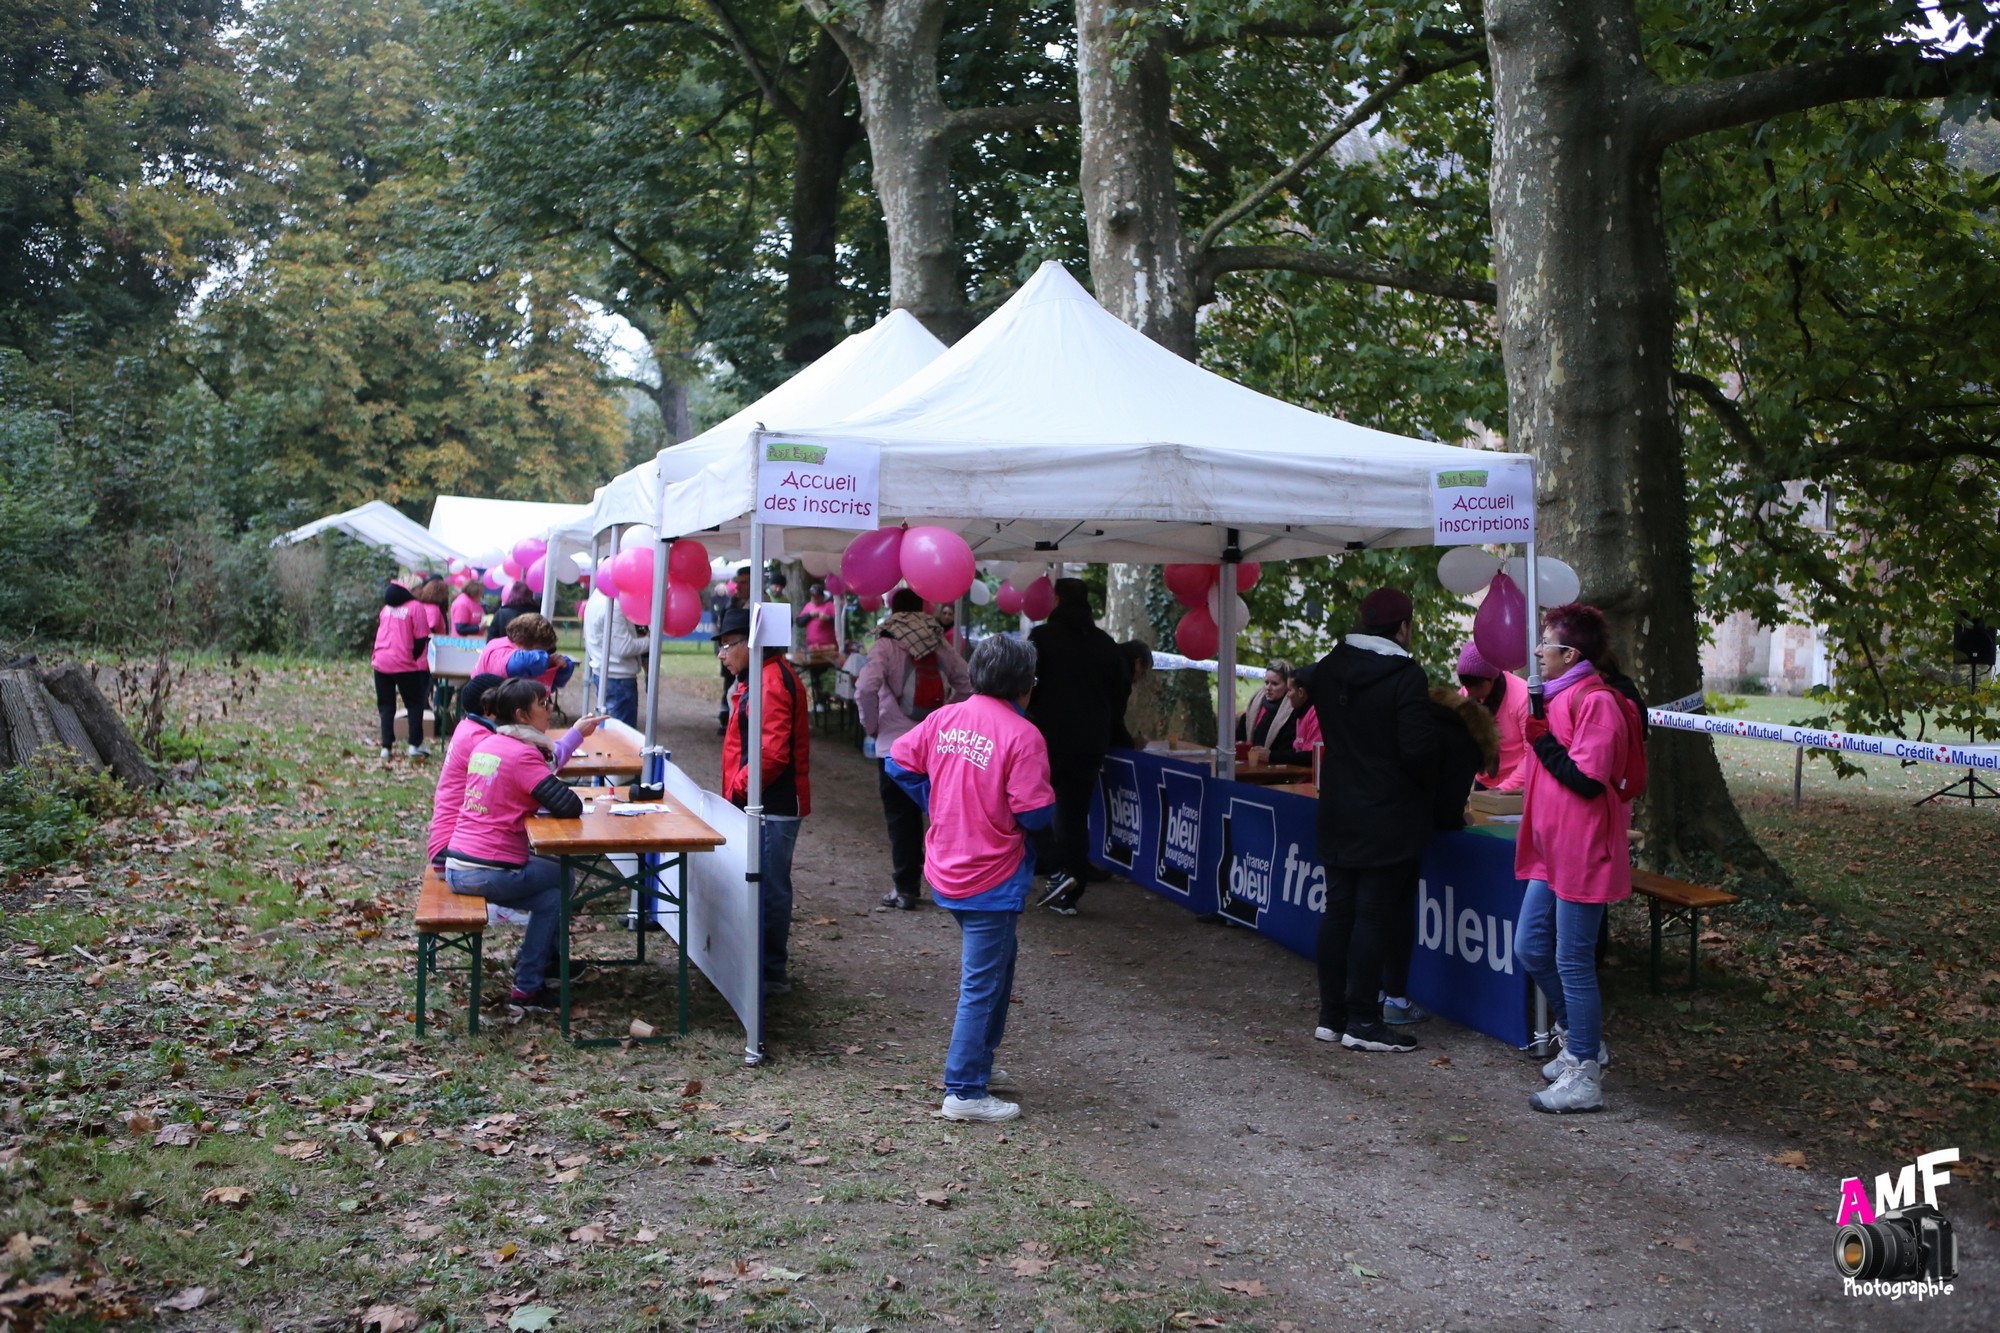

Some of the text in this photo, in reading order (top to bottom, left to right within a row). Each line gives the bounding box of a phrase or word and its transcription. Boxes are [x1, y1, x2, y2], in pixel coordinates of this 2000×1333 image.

[781, 471, 856, 492] Accueil
[764, 494, 872, 516] des inscrits
[1452, 494, 1514, 512] Accueil
[1439, 516, 1530, 533] inscriptions
[938, 728, 994, 756] MARCHER
[1663, 714, 1695, 728] Mutuel
[1704, 719, 1735, 735] Crédit
[1747, 725, 1783, 740] Mutuel
[1793, 731, 1828, 747] Crédit
[1842, 737, 1883, 753] Mutuel
[1896, 743, 1934, 761] Crédit
[1952, 750, 1998, 769] Mutuel
[1108, 788, 1139, 831] bleu
[1181, 802, 1198, 821] france
[1166, 806, 1198, 853] bleu
[1165, 844, 1195, 869] bourgogne
[1246, 852, 1269, 872] france
[1229, 855, 1268, 905] bleu
[1282, 842, 1514, 975] fra bleu
